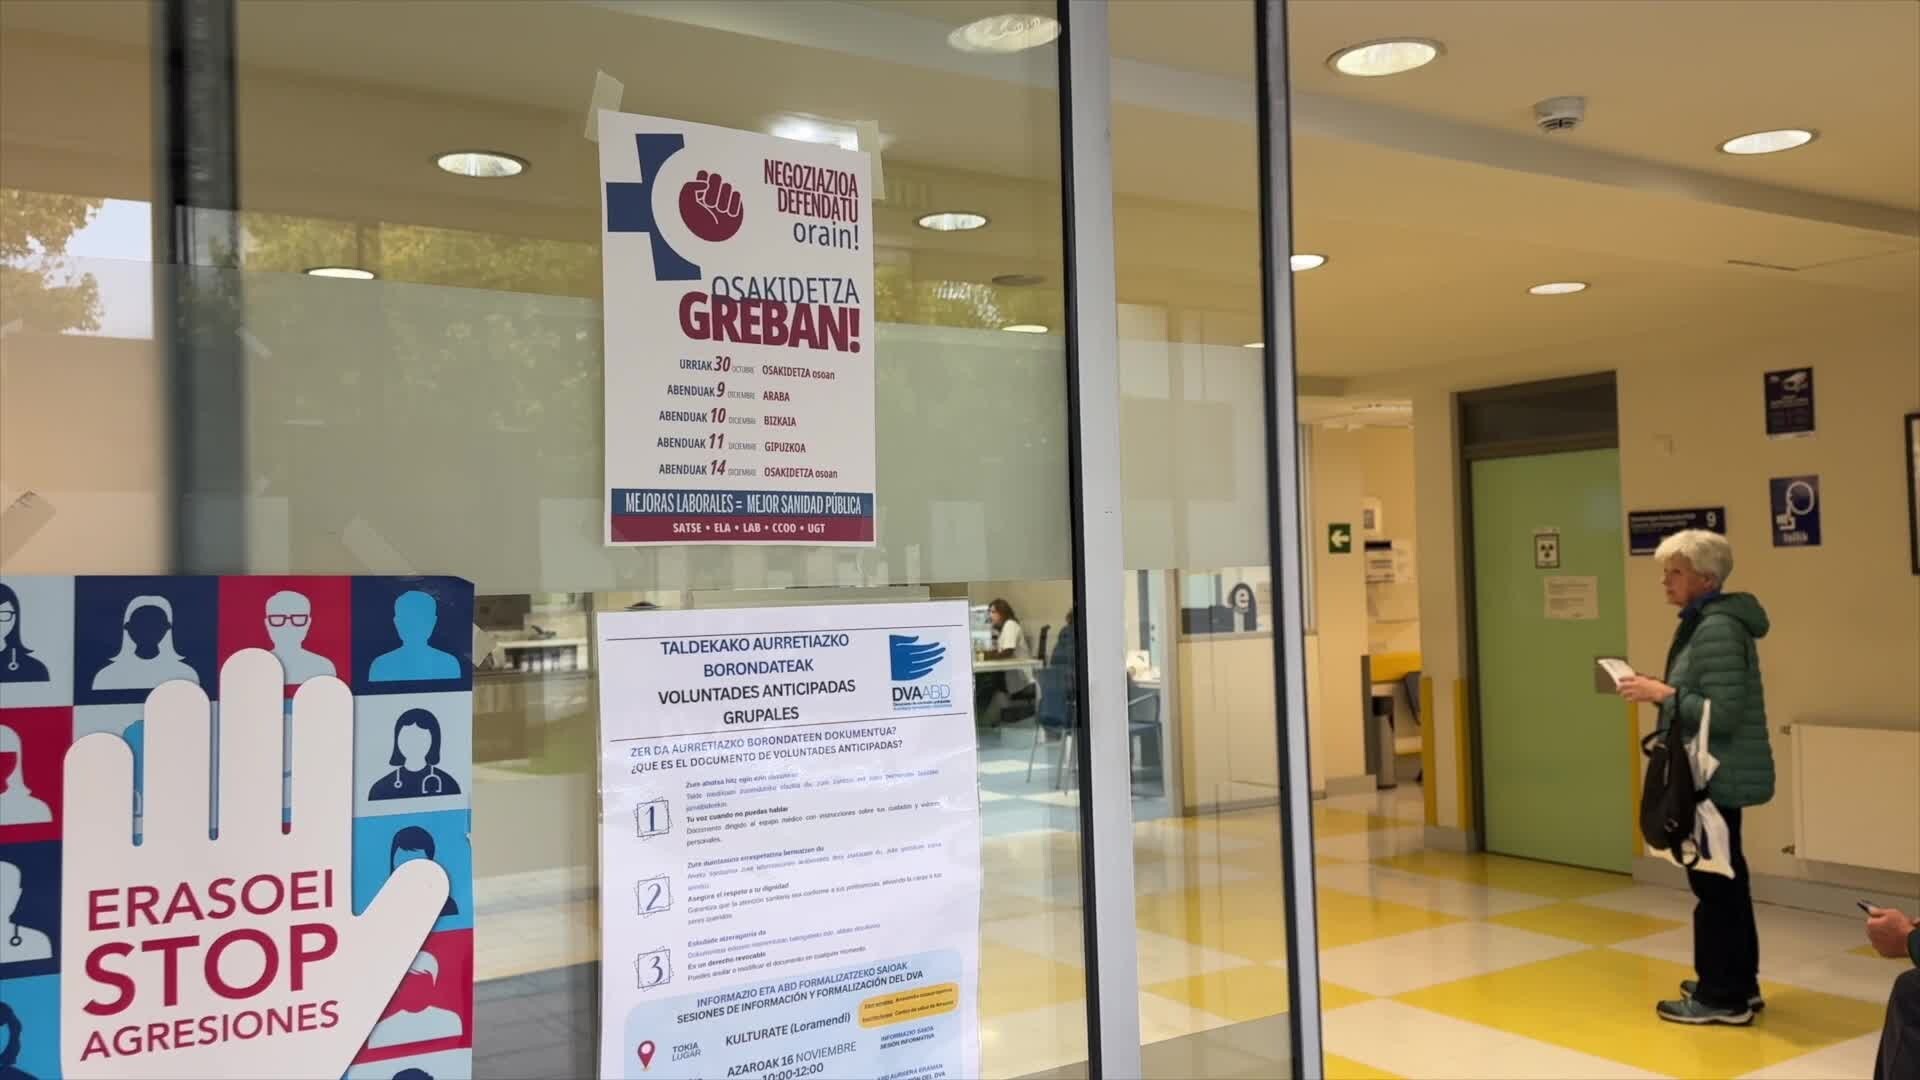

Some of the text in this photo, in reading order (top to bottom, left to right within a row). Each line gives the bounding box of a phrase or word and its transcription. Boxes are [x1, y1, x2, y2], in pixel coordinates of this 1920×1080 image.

[764, 159, 858, 198] NEGOZIAZIOA
[777, 188, 858, 223] DEFENDATU
[793, 221, 859, 250] orain!
[712, 275, 860, 304] OSAKIDETZA
[679, 291, 860, 353] GREBAN!
[679, 359, 712, 371] URRIAK
[713, 356, 731, 373] 30
[762, 365, 810, 379] OSAKIDETZA
[812, 369, 835, 380] osoan
[667, 384, 715, 397] ABENDUAK
[716, 381, 725, 398] 9
[763, 390, 790, 402] ARABA
[659, 410, 707, 422] ABENDUAK
[710, 408, 726, 424] 10
[764, 415, 796, 427] BIZKAIA
[657, 437, 706, 449] ABENDUAK
[708, 433, 725, 449] 11
[764, 442, 806, 453] GIPUZKOA
[659, 463, 707, 475] ABENDUAK
[710, 459, 726, 476] 14
[764, 467, 814, 478] OSAKIDETZA
[815, 469, 838, 479] osoan
[625, 492, 674, 513] MEJORAS
[676, 493, 733, 513] LABORALES
[747, 494, 779, 513] MEJOR
[781, 495, 824, 514] SANIDAD
[825, 491, 862, 514] PÚBLICA
[673, 522, 825, 533] SATSE ELA LAB CCOO UGT
[1705, 511, 1717, 527] 9
[660, 633, 849, 655] TALDEKAKO AURRETIAZKO
[704, 658, 814, 677] BORONDATEAK
[658, 679, 856, 705] VOLUNTADES ANTICIPADAS
[723, 706, 800, 725] GRUPALES
[631, 726, 897, 758] ZER DA AURRETIAZKO BORONDATEEN DOKUMENTUA?
[631, 739, 903, 775] ¿QUE ES EL DOCUMENTO DE VOLUNTADES ANTICIPADAS?
[644, 805, 655, 832] 1
[709, 812, 734, 821] cuando
[744, 809, 768, 818] puedas
[768, 805, 789, 814] hablar
[781, 815, 803, 824] médico
[88, 869, 333, 932] ERASOEI
[646, 882, 662, 911] 2
[687, 893, 715, 903] Asegura
[716, 891, 723, 899] el
[723, 889, 749, 899] respeto
[762, 882, 790, 893] dignidad
[83, 922, 339, 1017] STOP
[647, 955, 664, 985] 3
[707, 958, 734, 968] derecho
[735, 951, 767, 962] revocable
[697, 961, 908, 1008] INFORMAZIO ETA ABD FORMALIZATZEKO SAIOAK
[677, 1007, 725, 1025] SESIONES
[726, 1004, 740, 1015] DE
[741, 991, 808, 1012] INFORMACIÓN
[809, 988, 816, 999] Y
[816, 977, 887, 999] FORMALIZACIÓN
[889, 973, 905, 985] DEL
[906, 970, 924, 982] DVA
[80, 1000, 339, 1062] AGRESIONES
[725, 1024, 789, 1047] KULTURATE
[790, 1011, 851, 1035] (Loramendi)
[880, 1029, 916, 1042] INFORMAZIO
[900, 1033, 935, 1046] INFORMATIVA
[672, 1041, 699, 1053] TOKIA
[672, 1049, 702, 1062] LUGAR
[727, 1041, 857, 1078] AZAROAK 16 NOVIEMBRE
[762, 1062, 824, 1080] 10:00-12:00
